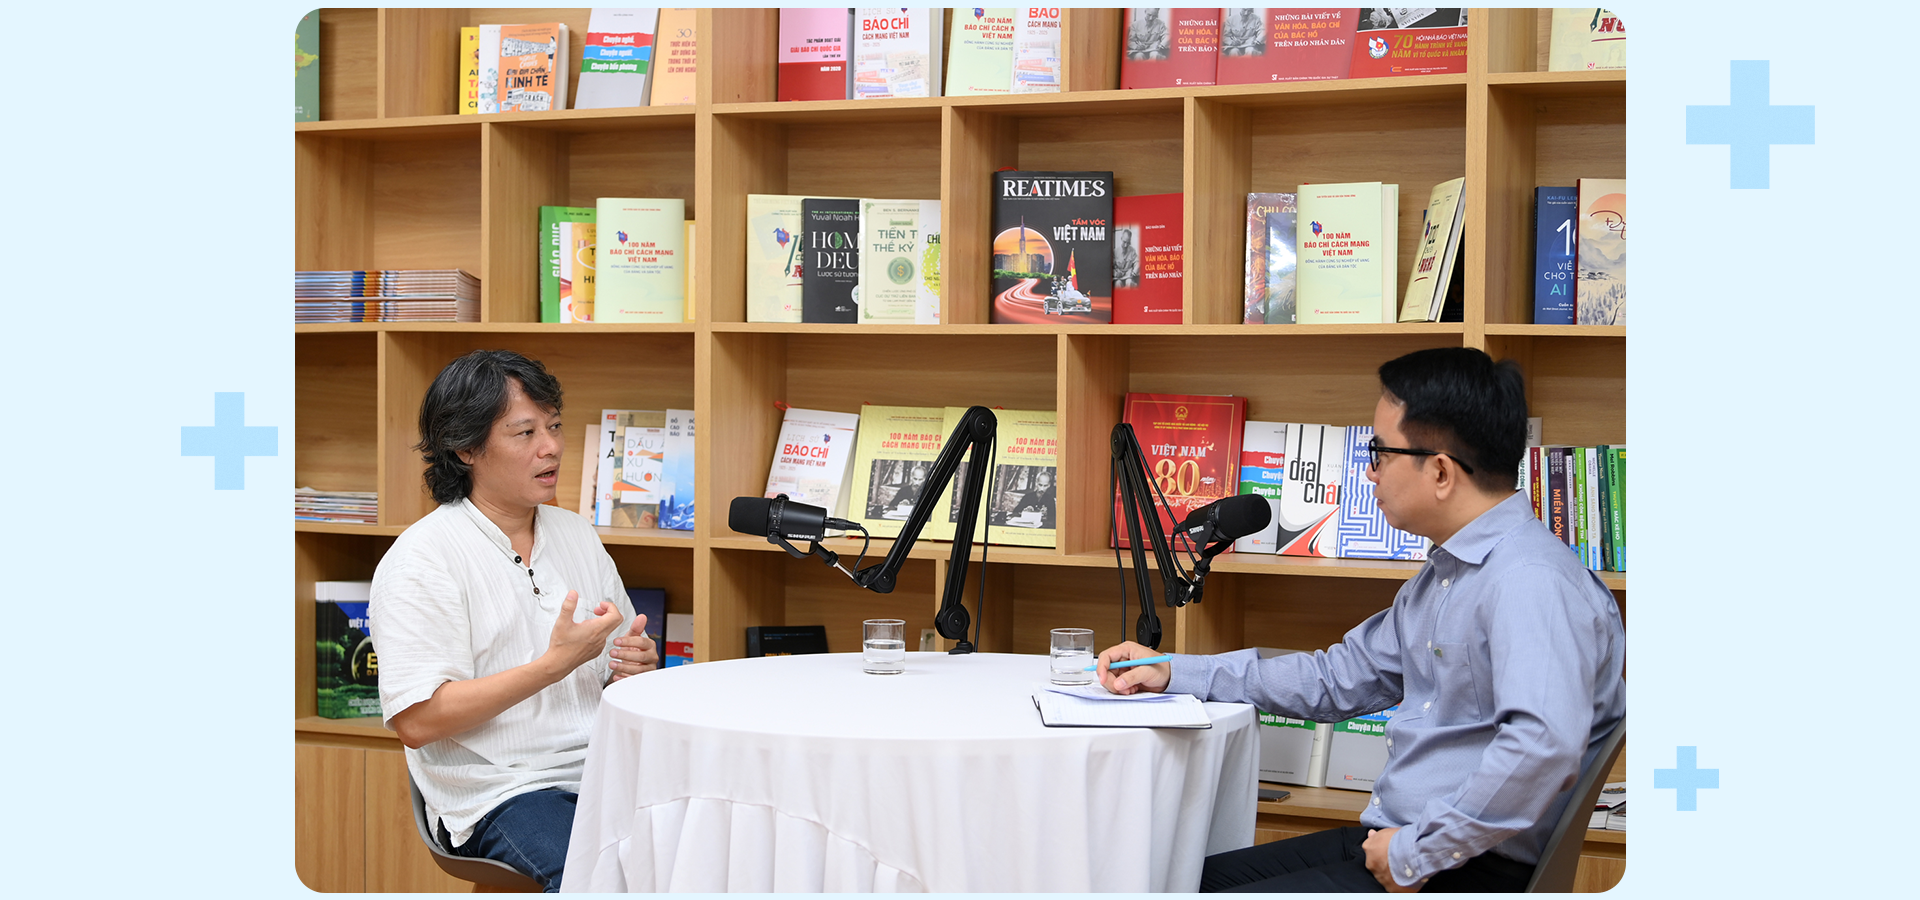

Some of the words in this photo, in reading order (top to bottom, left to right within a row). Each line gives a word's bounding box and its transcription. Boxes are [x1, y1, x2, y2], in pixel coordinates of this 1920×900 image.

[997, 16, 1012, 24] NĂM
[1275, 13, 1300, 21] NHỮNG
[1315, 11, 1331, 20] VIẾT
[1331, 11, 1342, 19] VỀ
[862, 16, 889, 31] BÁO
[891, 14, 910, 30] CHÍ
[1028, 20, 1041, 28] CÁCH
[1311, 21, 1327, 29] BÁO
[1328, 20, 1341, 28] CHÍ
[675, 28, 693, 38] 30
[992, 24, 1009, 32] CÁCH
[1179, 28, 1194, 36] VĂN
[862, 32, 874, 40] CÁCH
[889, 32, 899, 40] VIỆT
[982, 32, 996, 40] VIỆT
[1274, 31, 1289, 39] CỦA
[1307, 30, 1318, 38] HỒ
[1274, 39, 1293, 47] TRÊN
[1294, 39, 1309, 47] BÁO
[1309, 38, 1330, 46] NHÂN
[1330, 37, 1346, 45] DÂN
[1394, 34, 1414, 49] 70
[1178, 44, 1197, 52] TRÊN
[1198, 44, 1213, 52] BÁO
[1392, 49, 1412, 58] NĂM
[505, 76, 533, 88] KINH
[1003, 180, 1106, 197] REATIMES
[1072, 217, 1088, 225] TẦM
[1053, 223, 1078, 244] VIỆT
[1080, 226, 1106, 241] NAM
[1336, 231, 1351, 239] NĂM
[812, 230, 860, 250] HOM
[1304, 240, 1317, 248] BÁO
[1318, 240, 1330, 248] CHÍ
[1331, 240, 1349, 248] CÁCH
[1350, 240, 1370, 249] MẠNG
[873, 240, 895, 252] THẾ
[899, 240, 915, 252] KỶ
[1322, 248, 1336, 257] VIỆT
[627, 255, 641, 263] VIỆT
[1145, 262, 1156, 270] CỦA
[1157, 262, 1167, 270] BÁC
[1168, 261, 1175, 269] HỒ
[1159, 270, 1168, 278] BÁO
[1544, 271, 1566, 280] CHO
[1550, 283, 1567, 295] AI
[889, 432, 901, 440] 100
[903, 431, 918, 440] NĂM
[920, 433, 932, 441] BÁO
[1015, 437, 1028, 445] 100
[1030, 436, 1044, 446] NĂM
[627, 436, 654, 450] DẤU
[882, 440, 899, 448] CÁCH
[921, 441, 935, 451] VIỆT
[783, 441, 809, 457] BÁO
[810, 445, 830, 459] CHÍ
[1007, 445, 1025, 454] CÁCH
[1151, 443, 1177, 457] VIỆT
[1181, 446, 1207, 457] NAM
[627, 458, 643, 468] XU
[1153, 458, 1200, 497] 80
[1553, 489, 1564, 514] MIỀN
[1347, 721, 1371, 733] Chuyện
[1372, 722, 1384, 733] bốn
